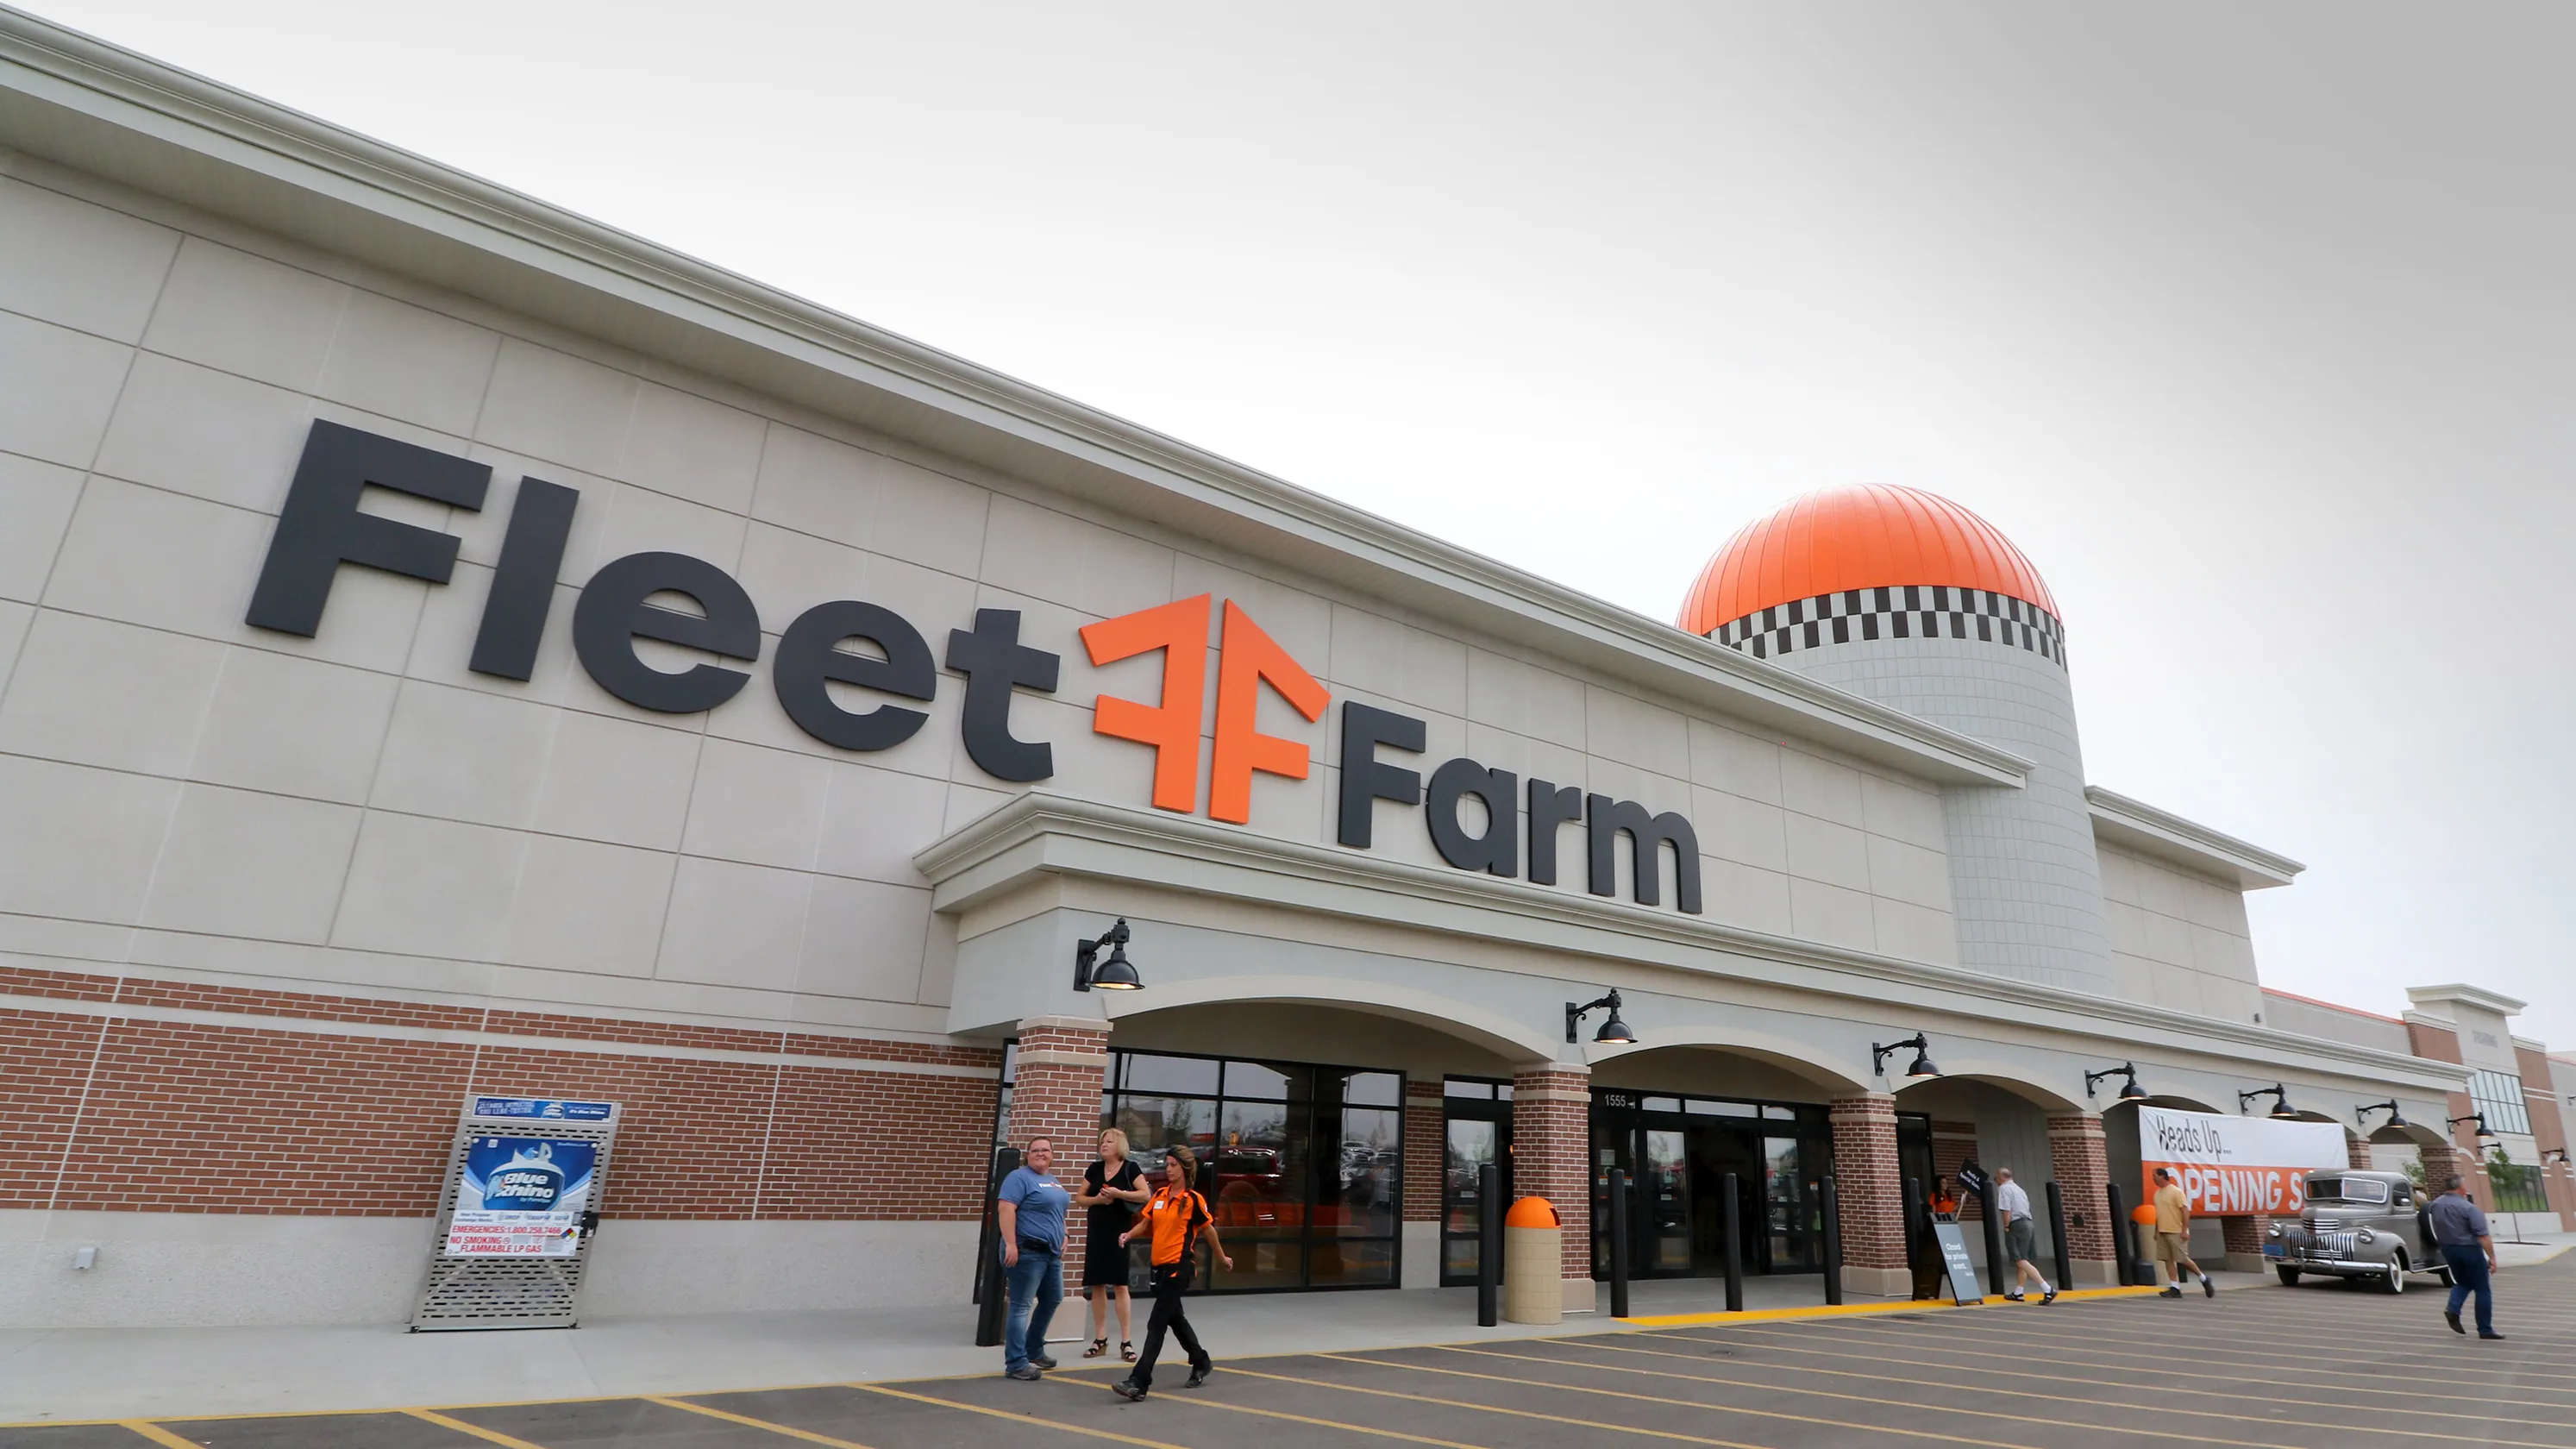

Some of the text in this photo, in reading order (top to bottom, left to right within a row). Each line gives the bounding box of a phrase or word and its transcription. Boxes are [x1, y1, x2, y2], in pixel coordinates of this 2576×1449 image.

[245, 417, 1061, 782] Fleet
[1338, 699, 1703, 915] Farm
[1604, 1095, 1626, 1107] 1555
[2157, 1114, 2202, 1154] Heads
[504, 1172, 549, 1185] Blue
[449, 1236, 503, 1245] NO SMOKING
[460, 1244, 542, 1253] FLAMMABLE LP GAS
